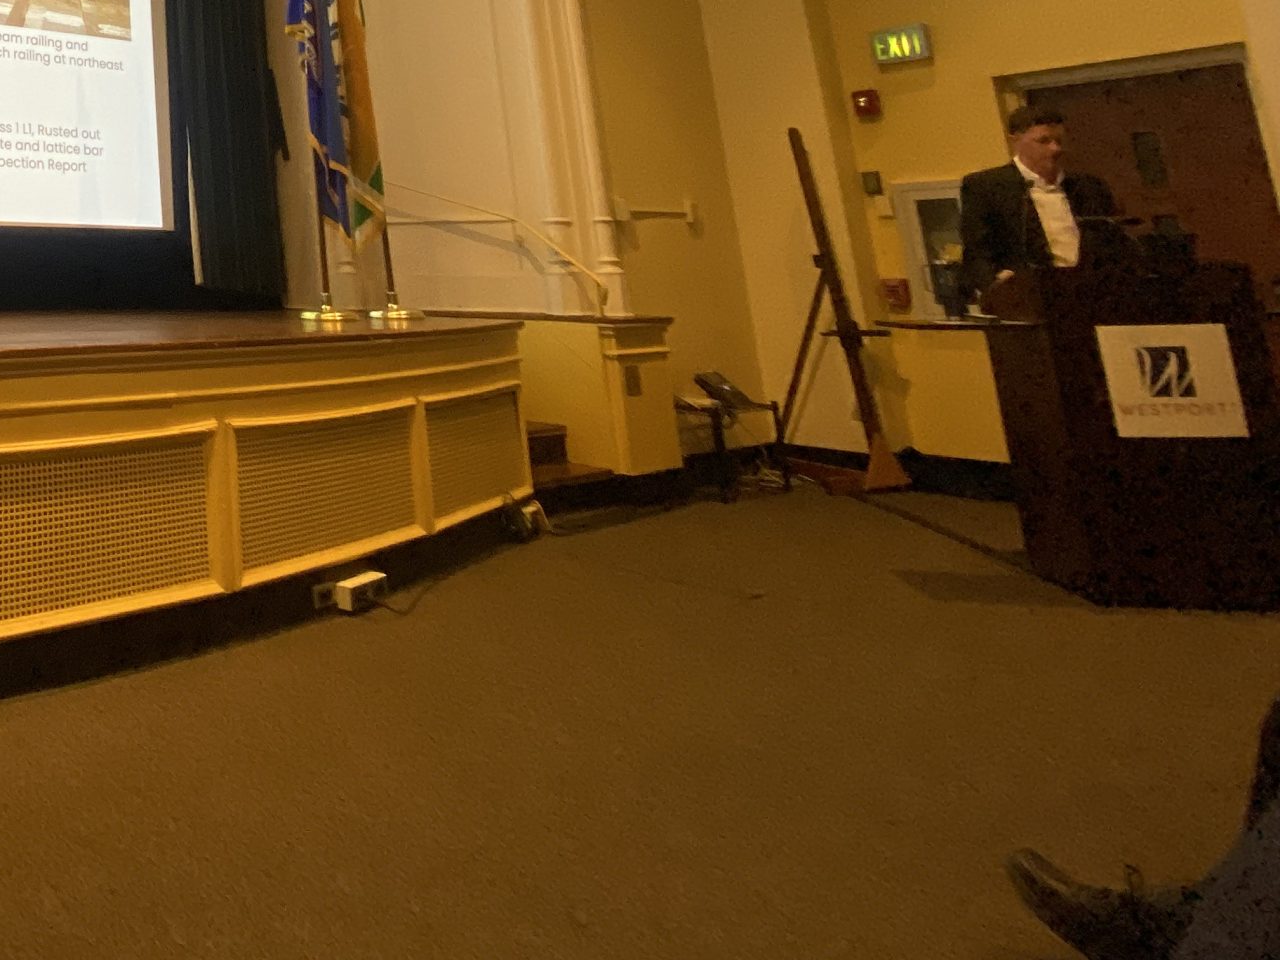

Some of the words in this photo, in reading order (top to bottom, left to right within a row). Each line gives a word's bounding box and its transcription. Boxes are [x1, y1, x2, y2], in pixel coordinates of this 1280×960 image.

[25, 35, 63, 52] railing
[65, 39, 89, 52] and
[13, 48, 51, 66] railing
[53, 53, 67, 65] at
[68, 55, 124, 71] northeast
[37, 124, 78, 139] Rusted
[81, 129, 101, 140] out
[15, 139, 40, 152] and
[42, 141, 80, 155] lattice
[83, 144, 104, 157] bar
[47, 161, 87, 174] Report
